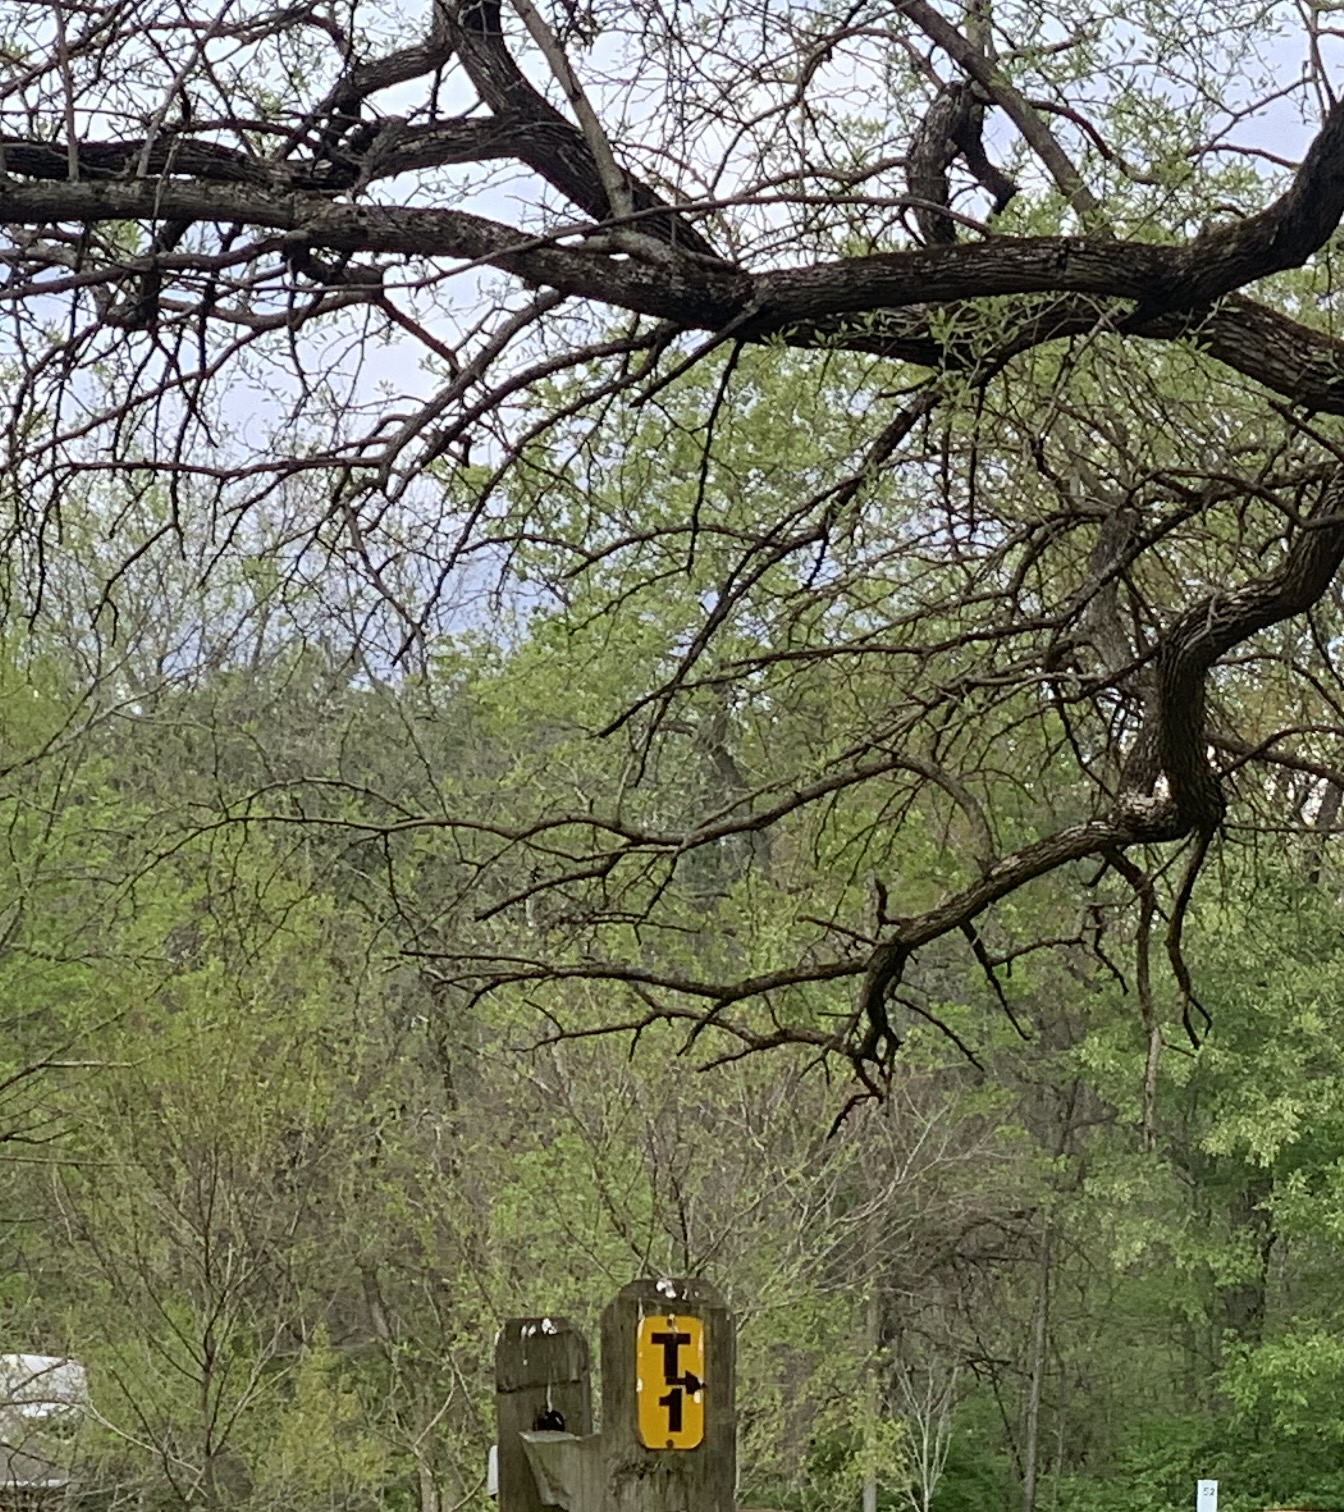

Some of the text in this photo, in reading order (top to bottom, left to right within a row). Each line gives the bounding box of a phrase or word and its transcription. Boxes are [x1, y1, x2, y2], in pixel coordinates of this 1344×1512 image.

[651, 1333, 691, 1378] T
[659, 1388, 682, 1432] 1
[1203, 1487, 1215, 1496] 52
